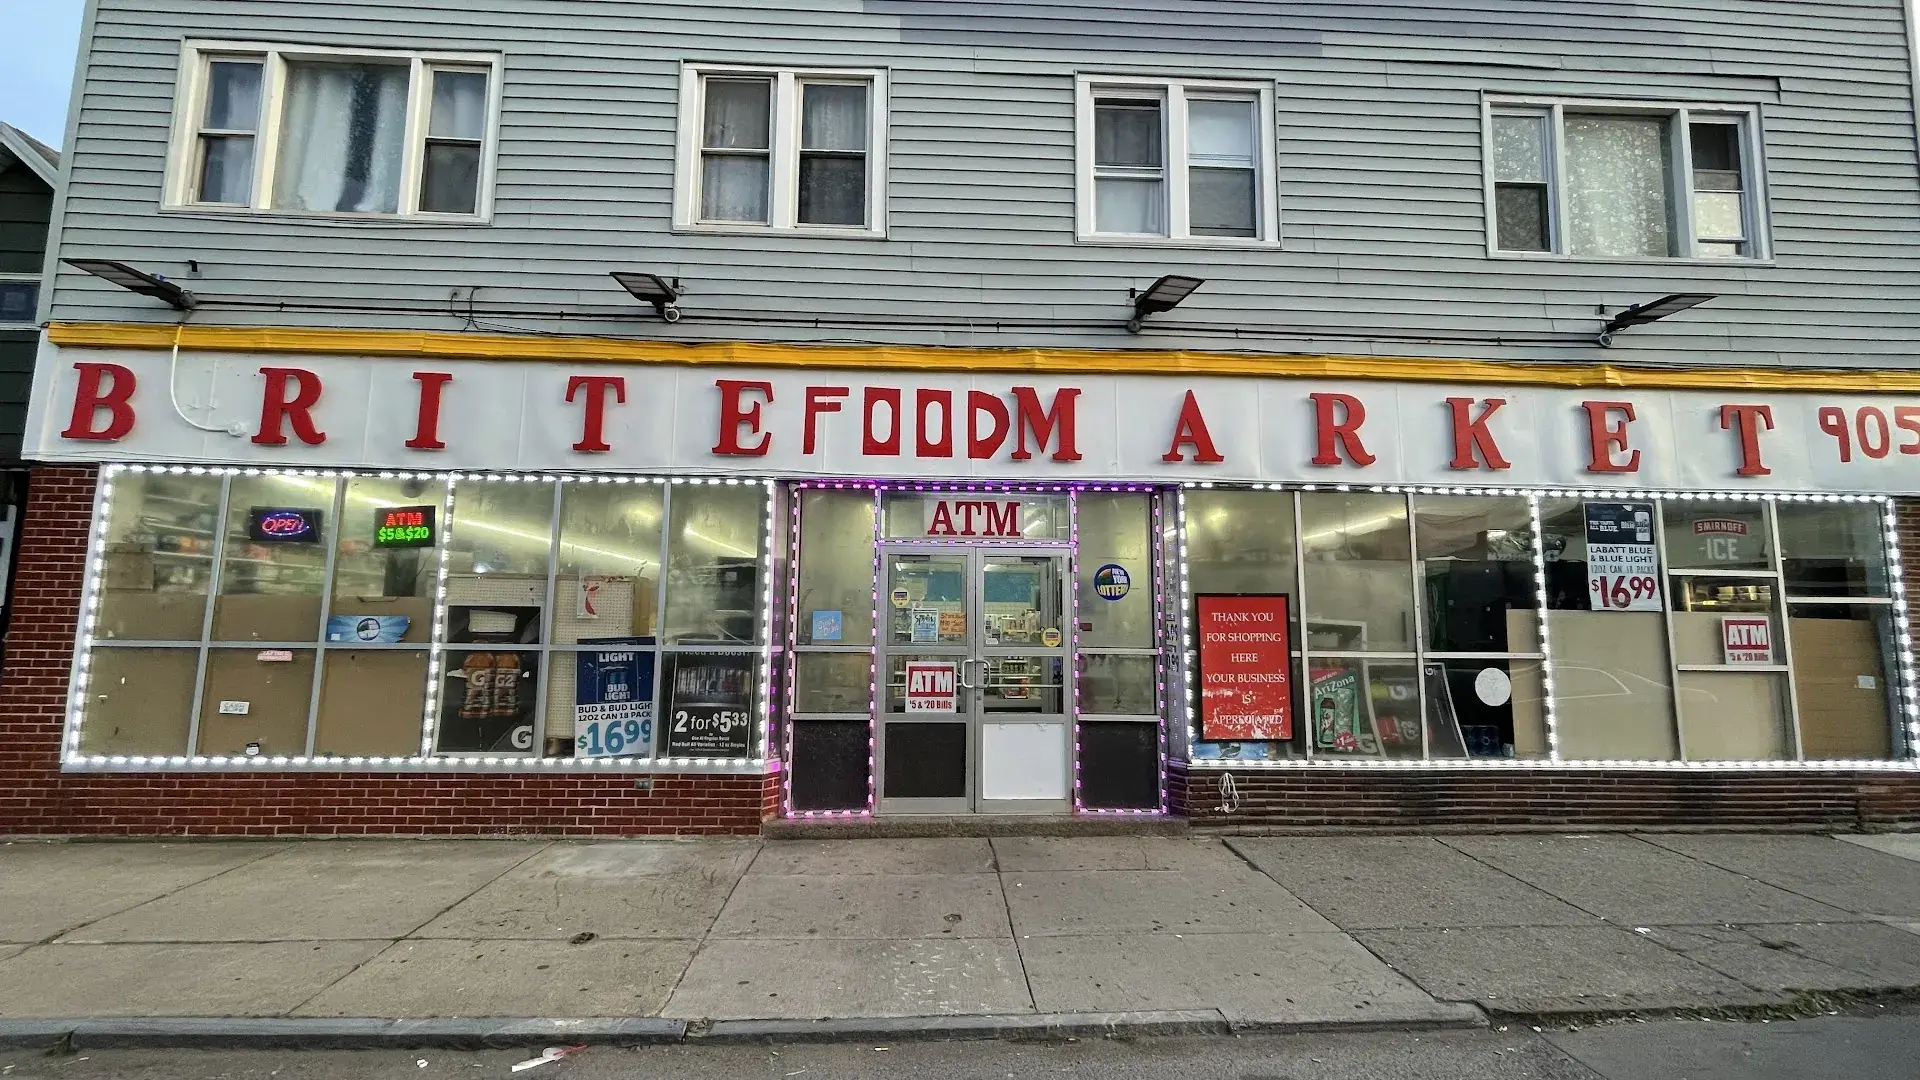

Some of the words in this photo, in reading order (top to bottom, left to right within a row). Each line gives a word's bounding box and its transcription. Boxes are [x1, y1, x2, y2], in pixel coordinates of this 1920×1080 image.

[62, 363, 774, 456] BRITE
[803, 386, 1010, 460] FOOD
[1011, 387, 1775, 476] MARKET
[262, 519, 304, 532] OPEN
[385, 512, 424, 526] ATM
[927, 501, 1020, 537] ATM
[1697, 520, 1743, 533] SMIRNOFF
[1706, 538, 1740, 561] ICE
[1636, 565, 1655, 574] PACKS
[1212, 612, 1249, 622] THANK
[1251, 612, 1274, 622] YOU
[1206, 632, 1226, 642] FOR
[1228, 632, 1281, 642] SHOPPING
[1728, 624, 1768, 646] ATM
[598, 652, 634, 663] LIGHT
[1231, 653, 1258, 662] HERE
[471, 670, 485, 687] G
[495, 674, 514, 687] G2
[909, 671, 953, 693] ATM
[1206, 673, 1235, 682] YOUR
[1237, 673, 1285, 683] BUSINESS
[607, 683, 628, 693] BUD
[1315, 675, 1355, 700] AriZona
[604, 691, 631, 701] LIGHT
[1242, 694, 1251, 704] IS
[578, 706, 597, 714] BUD
[600, 705, 606, 713] &
[609, 703, 628, 712] BUD
[936, 700, 953, 709] Bills
[674, 710, 688, 733] 2
[691, 715, 711, 730] for
[511, 725, 533, 749] G
